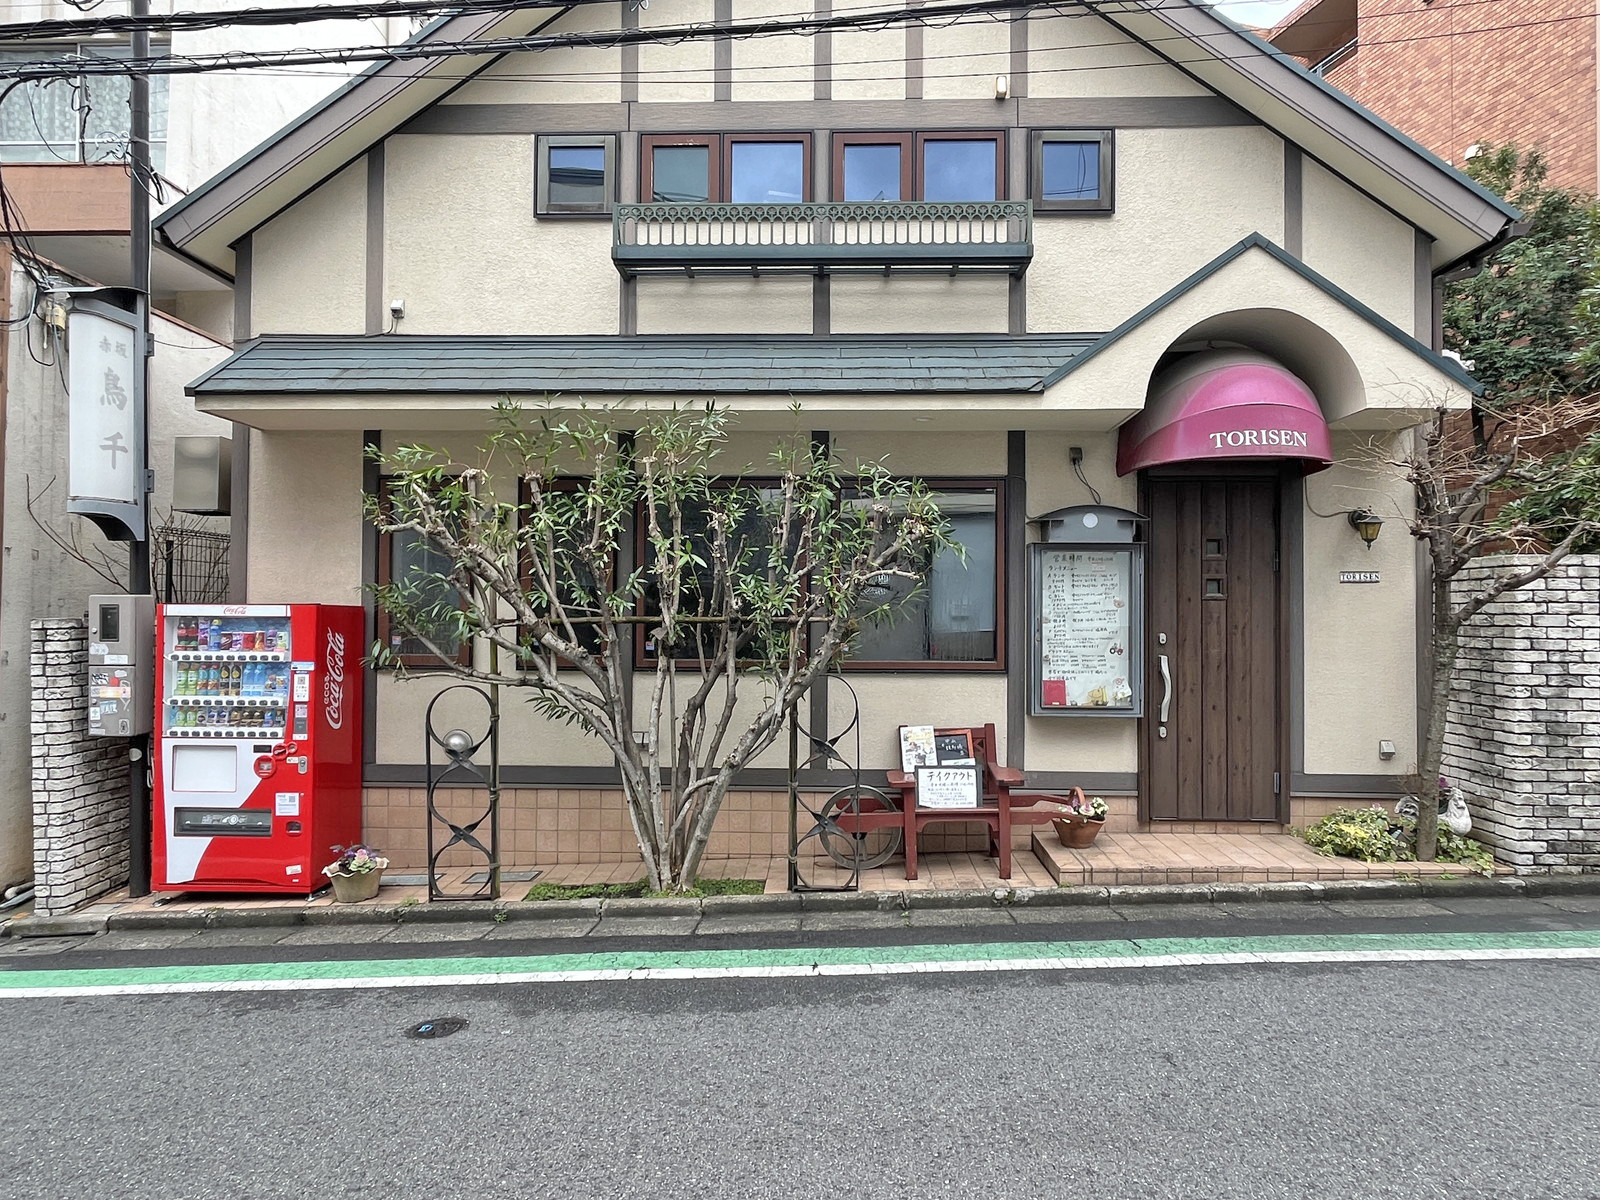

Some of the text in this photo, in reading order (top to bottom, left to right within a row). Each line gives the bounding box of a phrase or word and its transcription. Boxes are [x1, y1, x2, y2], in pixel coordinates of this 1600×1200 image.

[99, 366, 129, 470] 鳥千
[1209, 429, 1307, 449] TORISEN
[325, 626, 345, 730] Coca-Cola
[926, 771, 973, 782] テイクアウト
